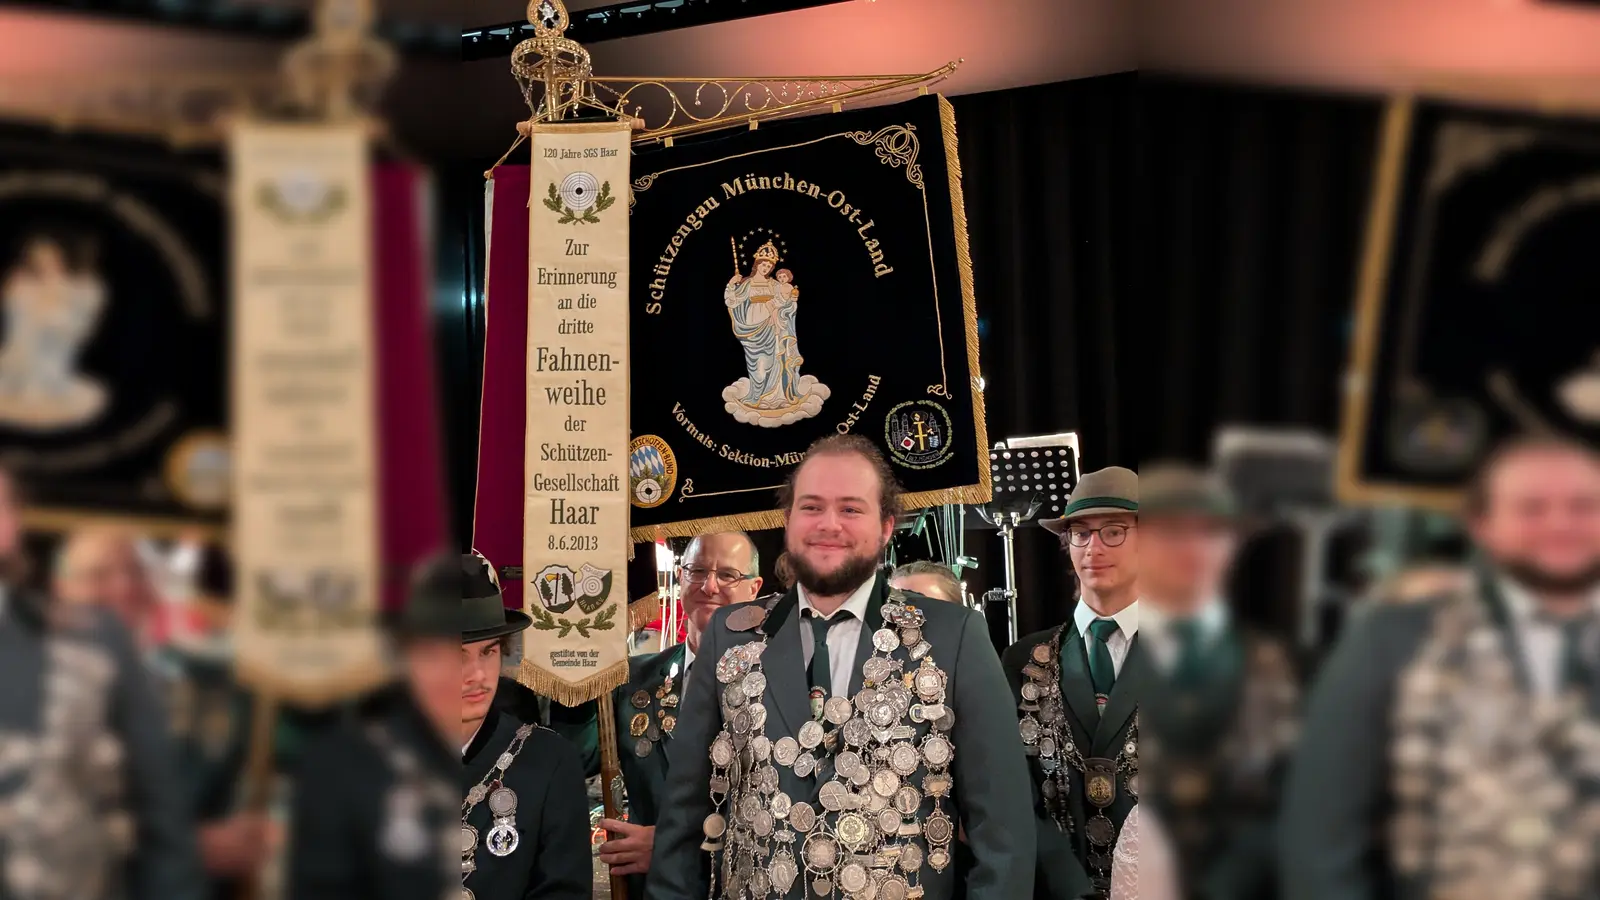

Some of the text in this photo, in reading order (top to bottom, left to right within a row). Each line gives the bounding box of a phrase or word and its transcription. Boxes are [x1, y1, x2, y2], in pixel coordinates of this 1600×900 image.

[543, 147, 618, 160] 120 Jahre SGS Haar
[565, 238, 589, 256] Zur
[645, 171, 895, 315] Schützengau München-Ost-Land
[536, 267, 617, 289] Erinnerung
[557, 293, 597, 310] an die
[557, 318, 594, 335] dritte
[536, 346, 620, 373] Fahnen-
[544, 379, 607, 406] weihe
[564, 415, 587, 432] der
[671, 401, 717, 452] Vormals:
[718, 444, 806, 468] Sektion-Mün
[540, 442, 613, 462] Schützen-
[533, 472, 620, 492] Gesellschaft
[549, 498, 600, 525] Haar
[547, 534, 598, 551] 8.6.2013
[550, 649, 575, 660] gestiftet
[589, 649, 600, 658] der
[551, 658, 598, 667] Gemeinde Haar
